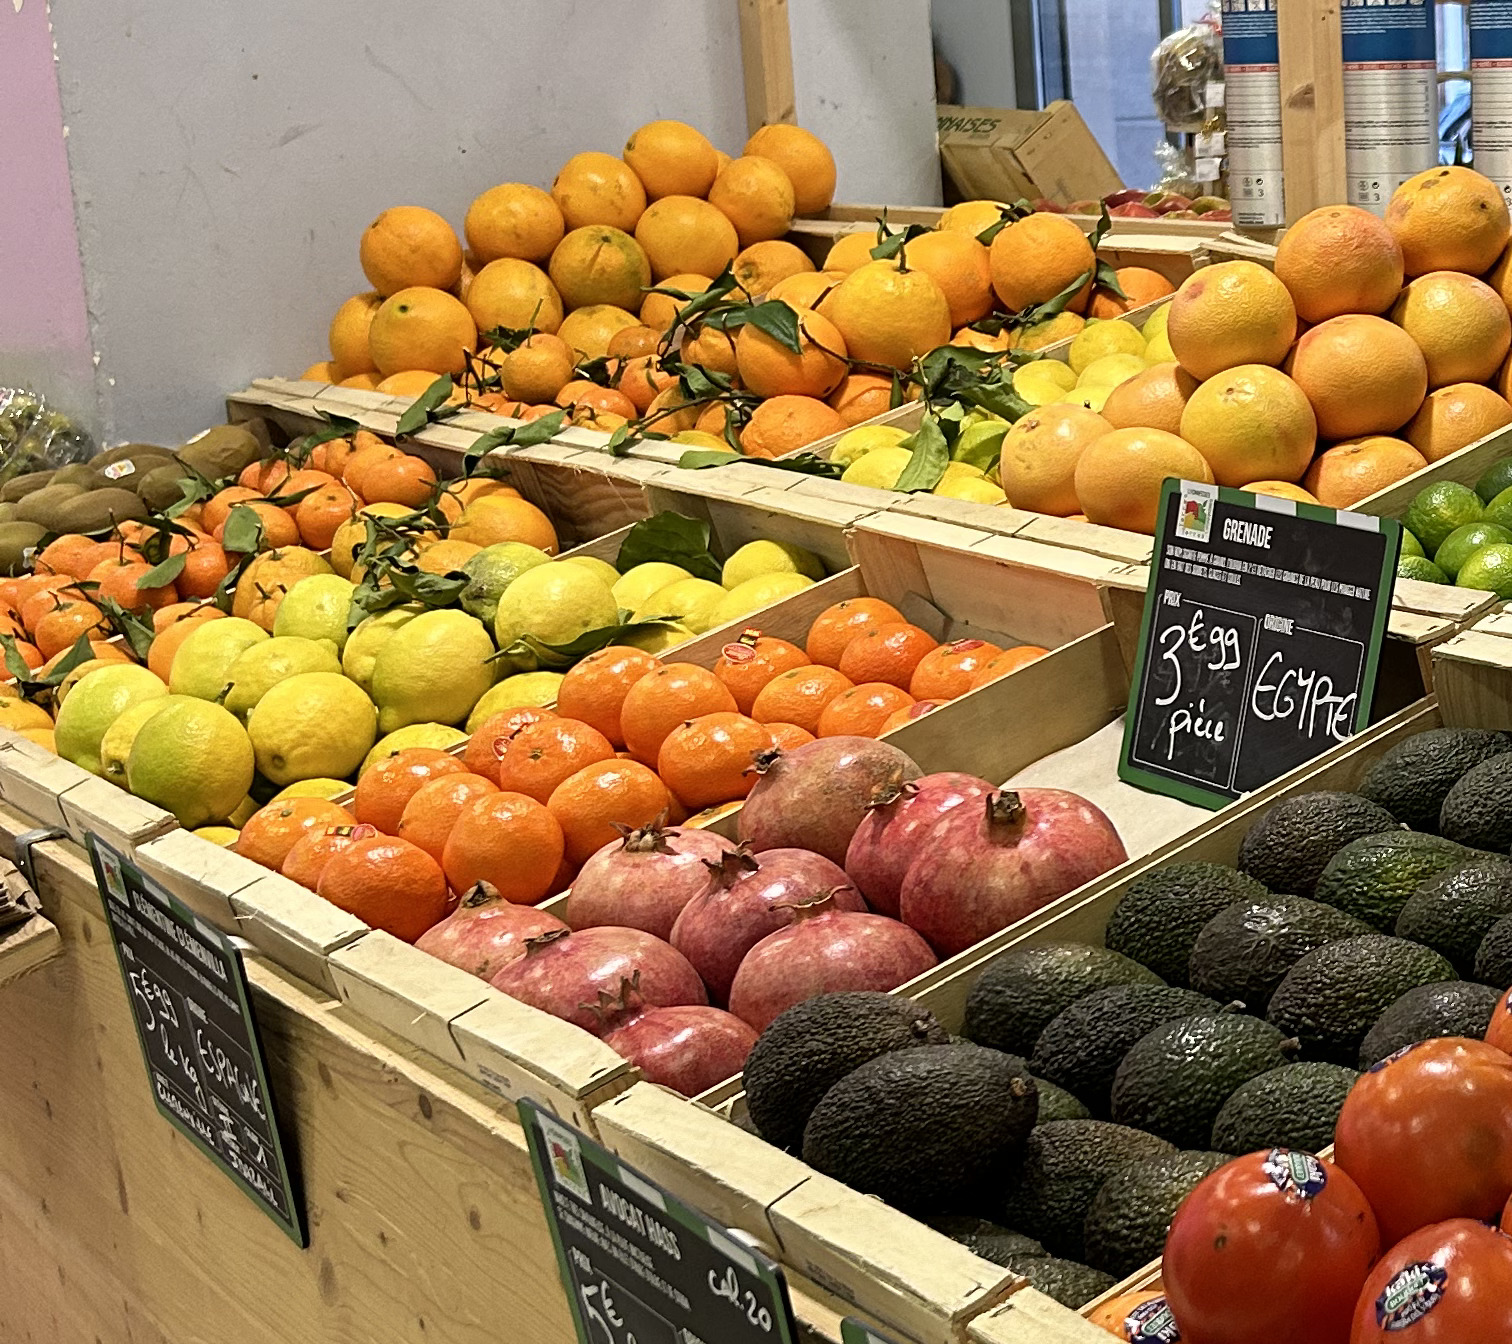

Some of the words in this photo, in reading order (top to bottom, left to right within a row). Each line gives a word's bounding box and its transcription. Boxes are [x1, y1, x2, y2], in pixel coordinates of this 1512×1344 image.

[1223, 517, 1274, 549] GRENADE
[1163, 590, 1181, 608] PRIX
[599, 1183, 647, 1237] AVOCAT
[644, 1214, 681, 1261] HASS
[1385, 1266, 1421, 1297] kaki
[744, 1291, 772, 1333] 20
